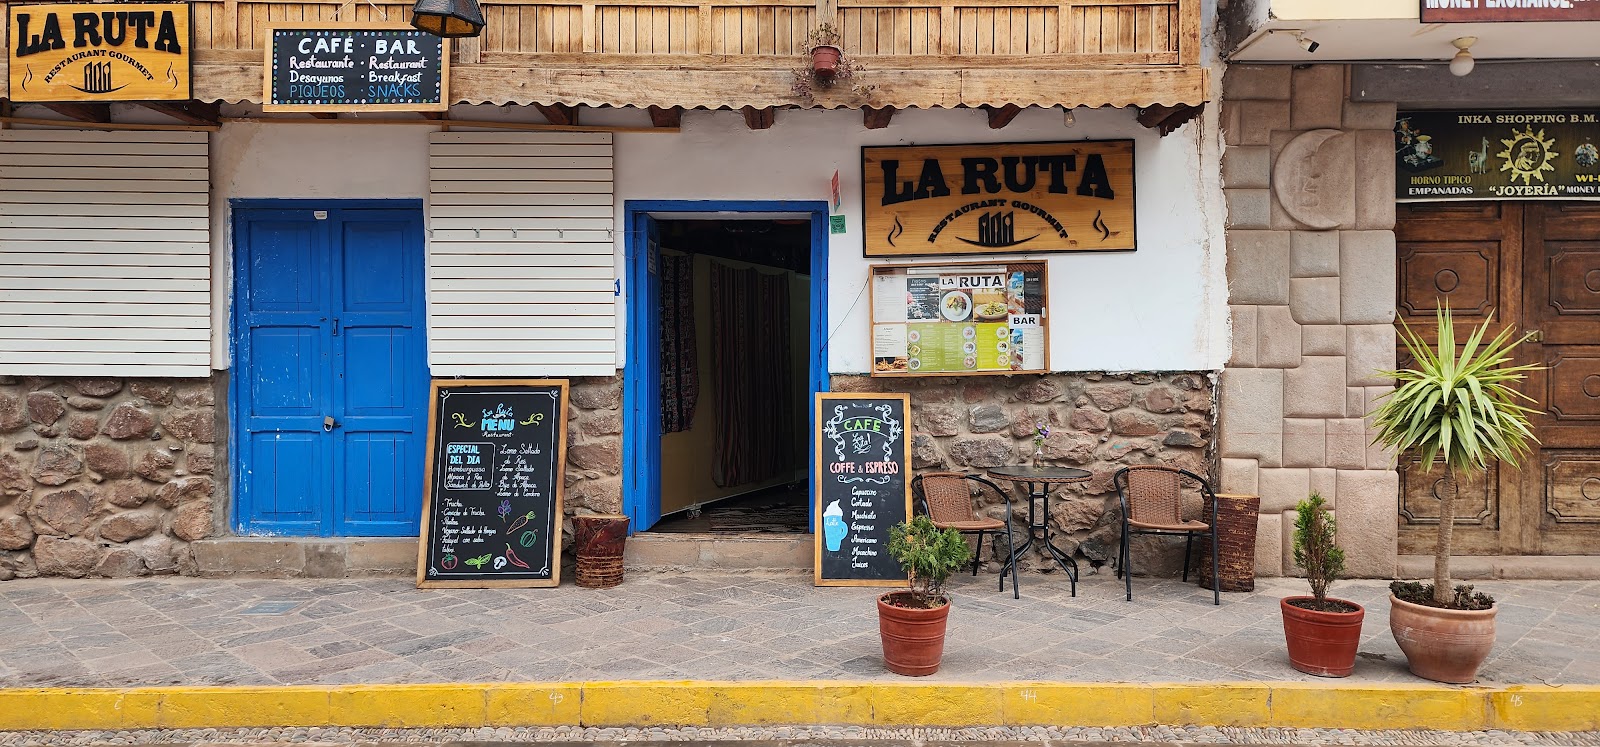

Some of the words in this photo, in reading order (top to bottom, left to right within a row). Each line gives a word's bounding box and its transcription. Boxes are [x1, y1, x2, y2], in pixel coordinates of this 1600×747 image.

[16, 13, 66, 57] LA
[73, 11, 182, 54] RUTA
[298, 36, 354, 54] CAFÉ
[376, 40, 421, 54] BAR
[44, 50, 106, 84] RESTAURANT
[108, 50, 154, 81] GOURMET
[290, 54, 354, 69] Restaurante
[368, 56, 428, 69] Restaurant
[290, 70, 344, 86] Desayunos
[368, 71, 423, 84] Breakfast
[290, 85, 346, 98] PIQUEOS
[368, 83, 421, 98] SNACKS
[1458, 116, 1492, 124] INKA
[1496, 114, 1566, 124] SHOPPING
[1570, 114, 1600, 123] B.M.
[881, 158, 950, 206] LA
[961, 154, 1115, 200] RUTA
[1410, 176, 1440, 184] HORNO
[1443, 176, 1472, 184] TIPICO
[1576, 174, 1600, 182] WI-
[1408, 186, 1474, 195] EMPANADAS
[1566, 186, 1596, 194] MONEY
[928, 199, 1007, 244] RESTAURANT
[1012, 200, 1069, 239] GOURMET
[960, 276, 1002, 287] RUTA
[1014, 316, 1036, 324] BAR
[496, 403, 514, 417] Ruta
[481, 418, 514, 430] MENU
[448, 444, 480, 454] ESPECIAL
[450, 456, 464, 464] DEL
[466, 456, 480, 464] DIA
[830, 462, 855, 474] COFFE
[858, 465, 864, 474] &
[865, 462, 898, 474] ESPRESO
[851, 498, 872, 506] Cortado
[1020, 690, 1036, 704] 44
[1510, 694, 1523, 707] 45
